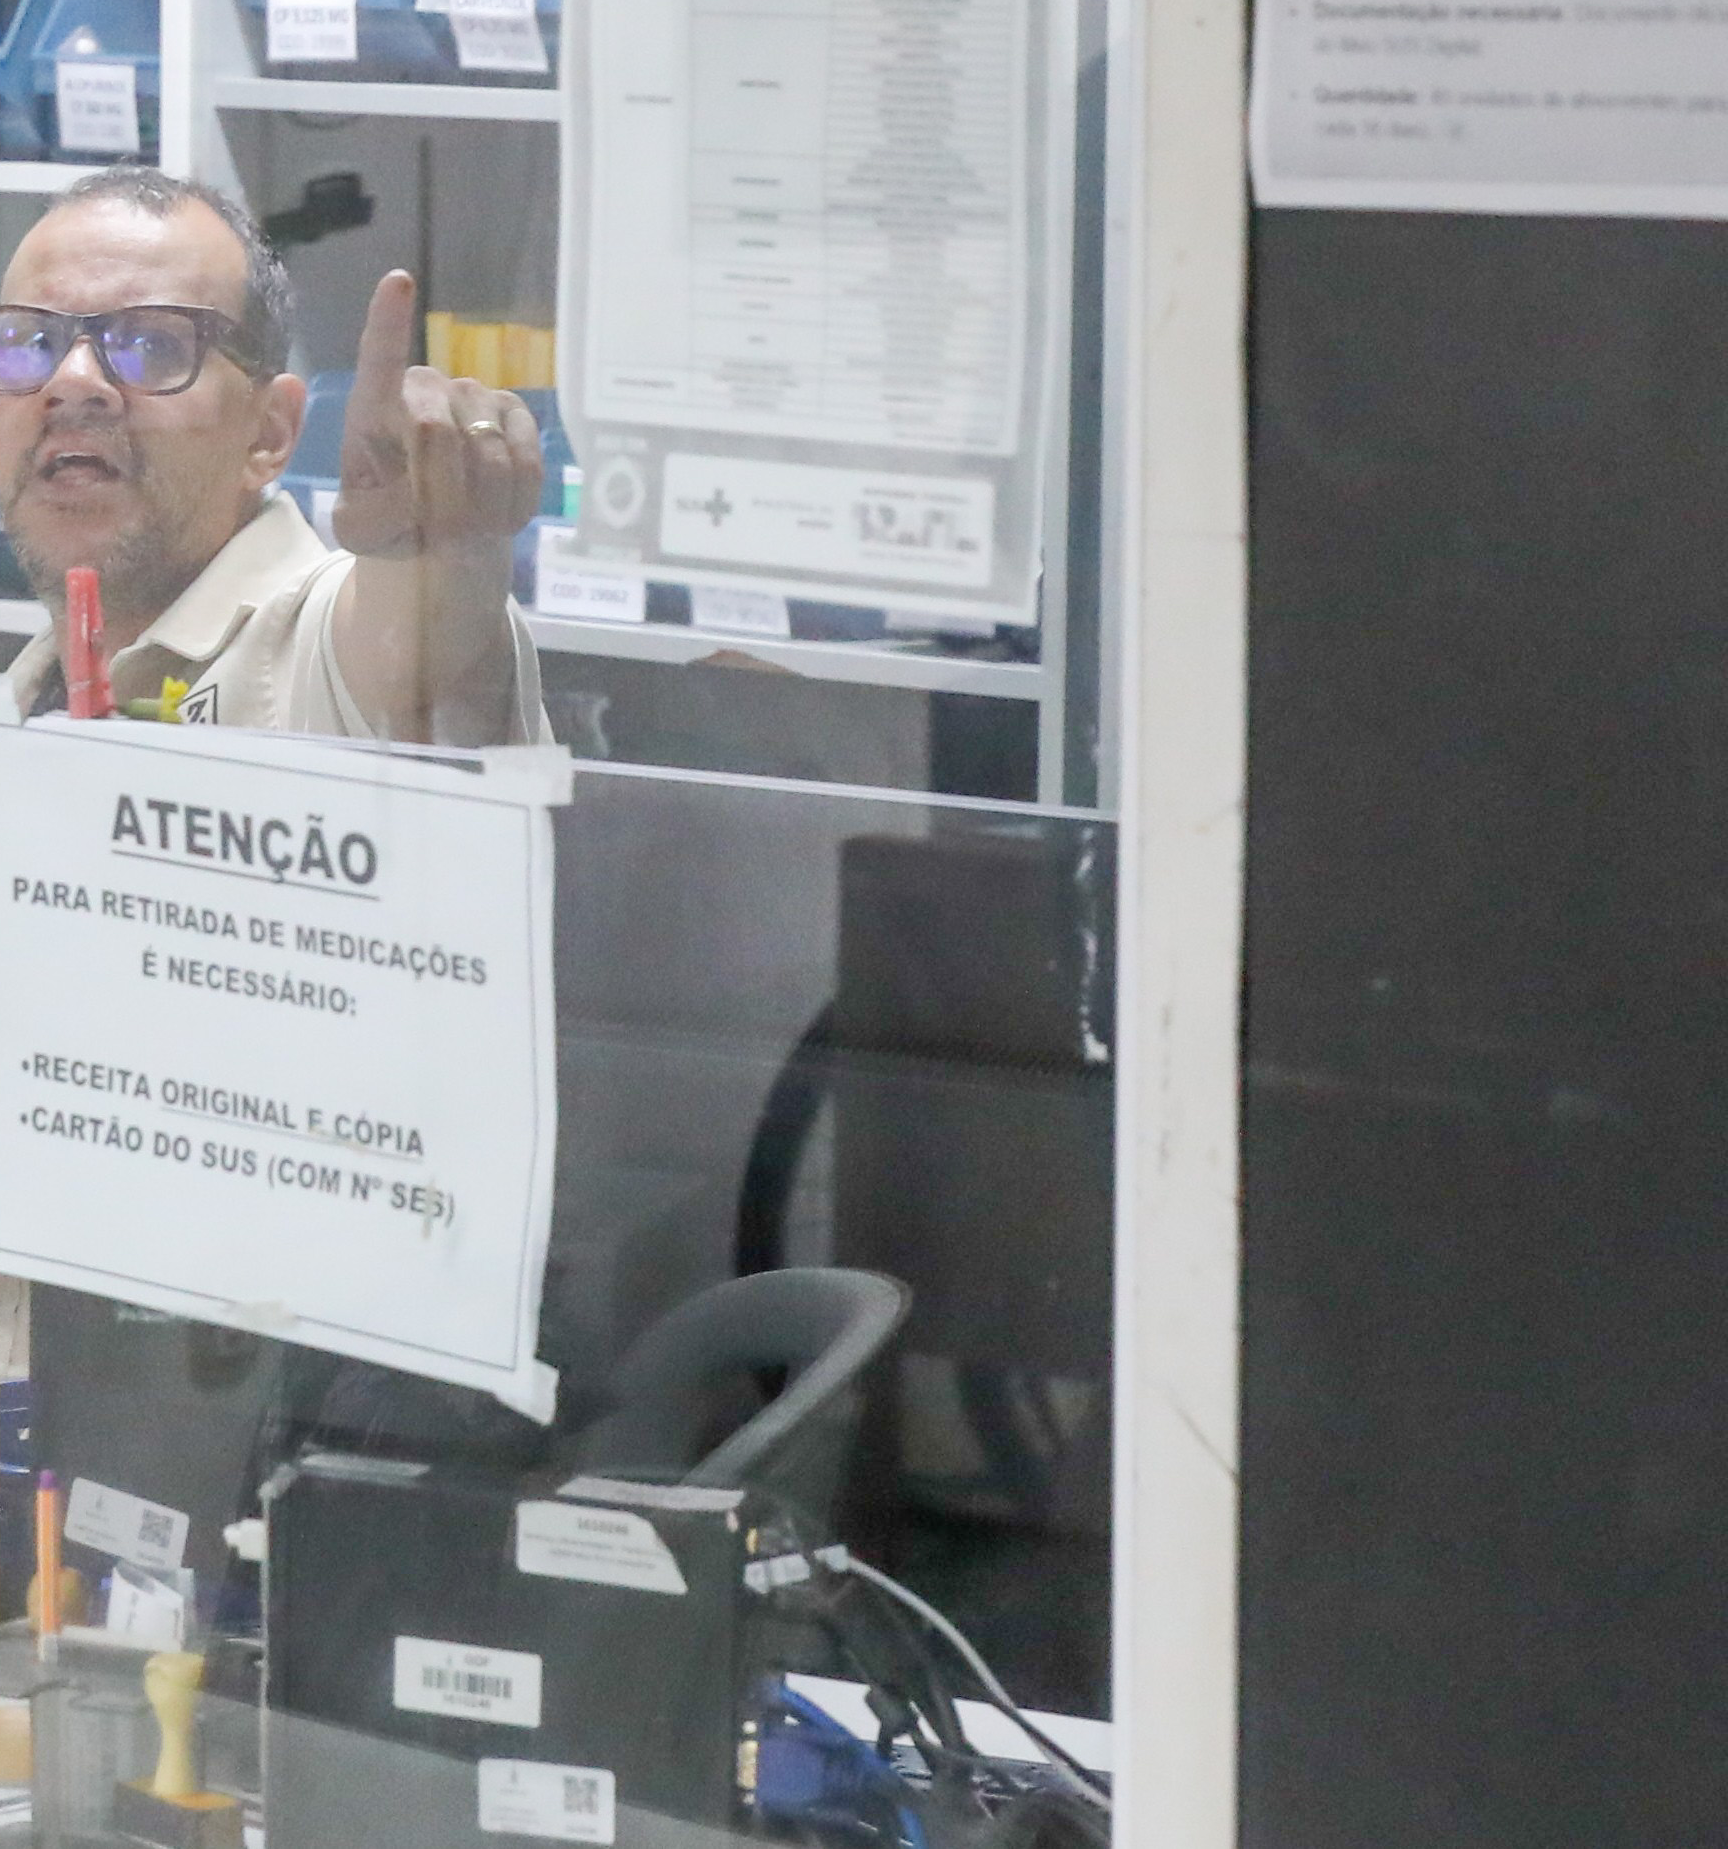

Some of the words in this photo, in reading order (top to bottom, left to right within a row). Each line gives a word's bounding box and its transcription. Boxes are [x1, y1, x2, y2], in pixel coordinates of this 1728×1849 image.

[111, 794, 379, 886] ATENÇÃO
[12, 875, 92, 913] PARA
[101, 889, 238, 940] RETIRADA
[248, 914, 285, 948] DE
[294, 924, 487, 986] MEDICAÇÕES
[141, 946, 158, 978] É
[168, 954, 357, 1017] NECESSÁRIO:
[161, 1079, 297, 1131] ORIGINAL
[307, 1108, 323, 1136] E
[333, 1111, 424, 1157] CÓPIA
[153, 1132, 192, 1163] DO
[201, 1142, 258, 1178] SUS
[267, 1153, 341, 1196] (COM
[390, 1181, 456, 1229] SES)
